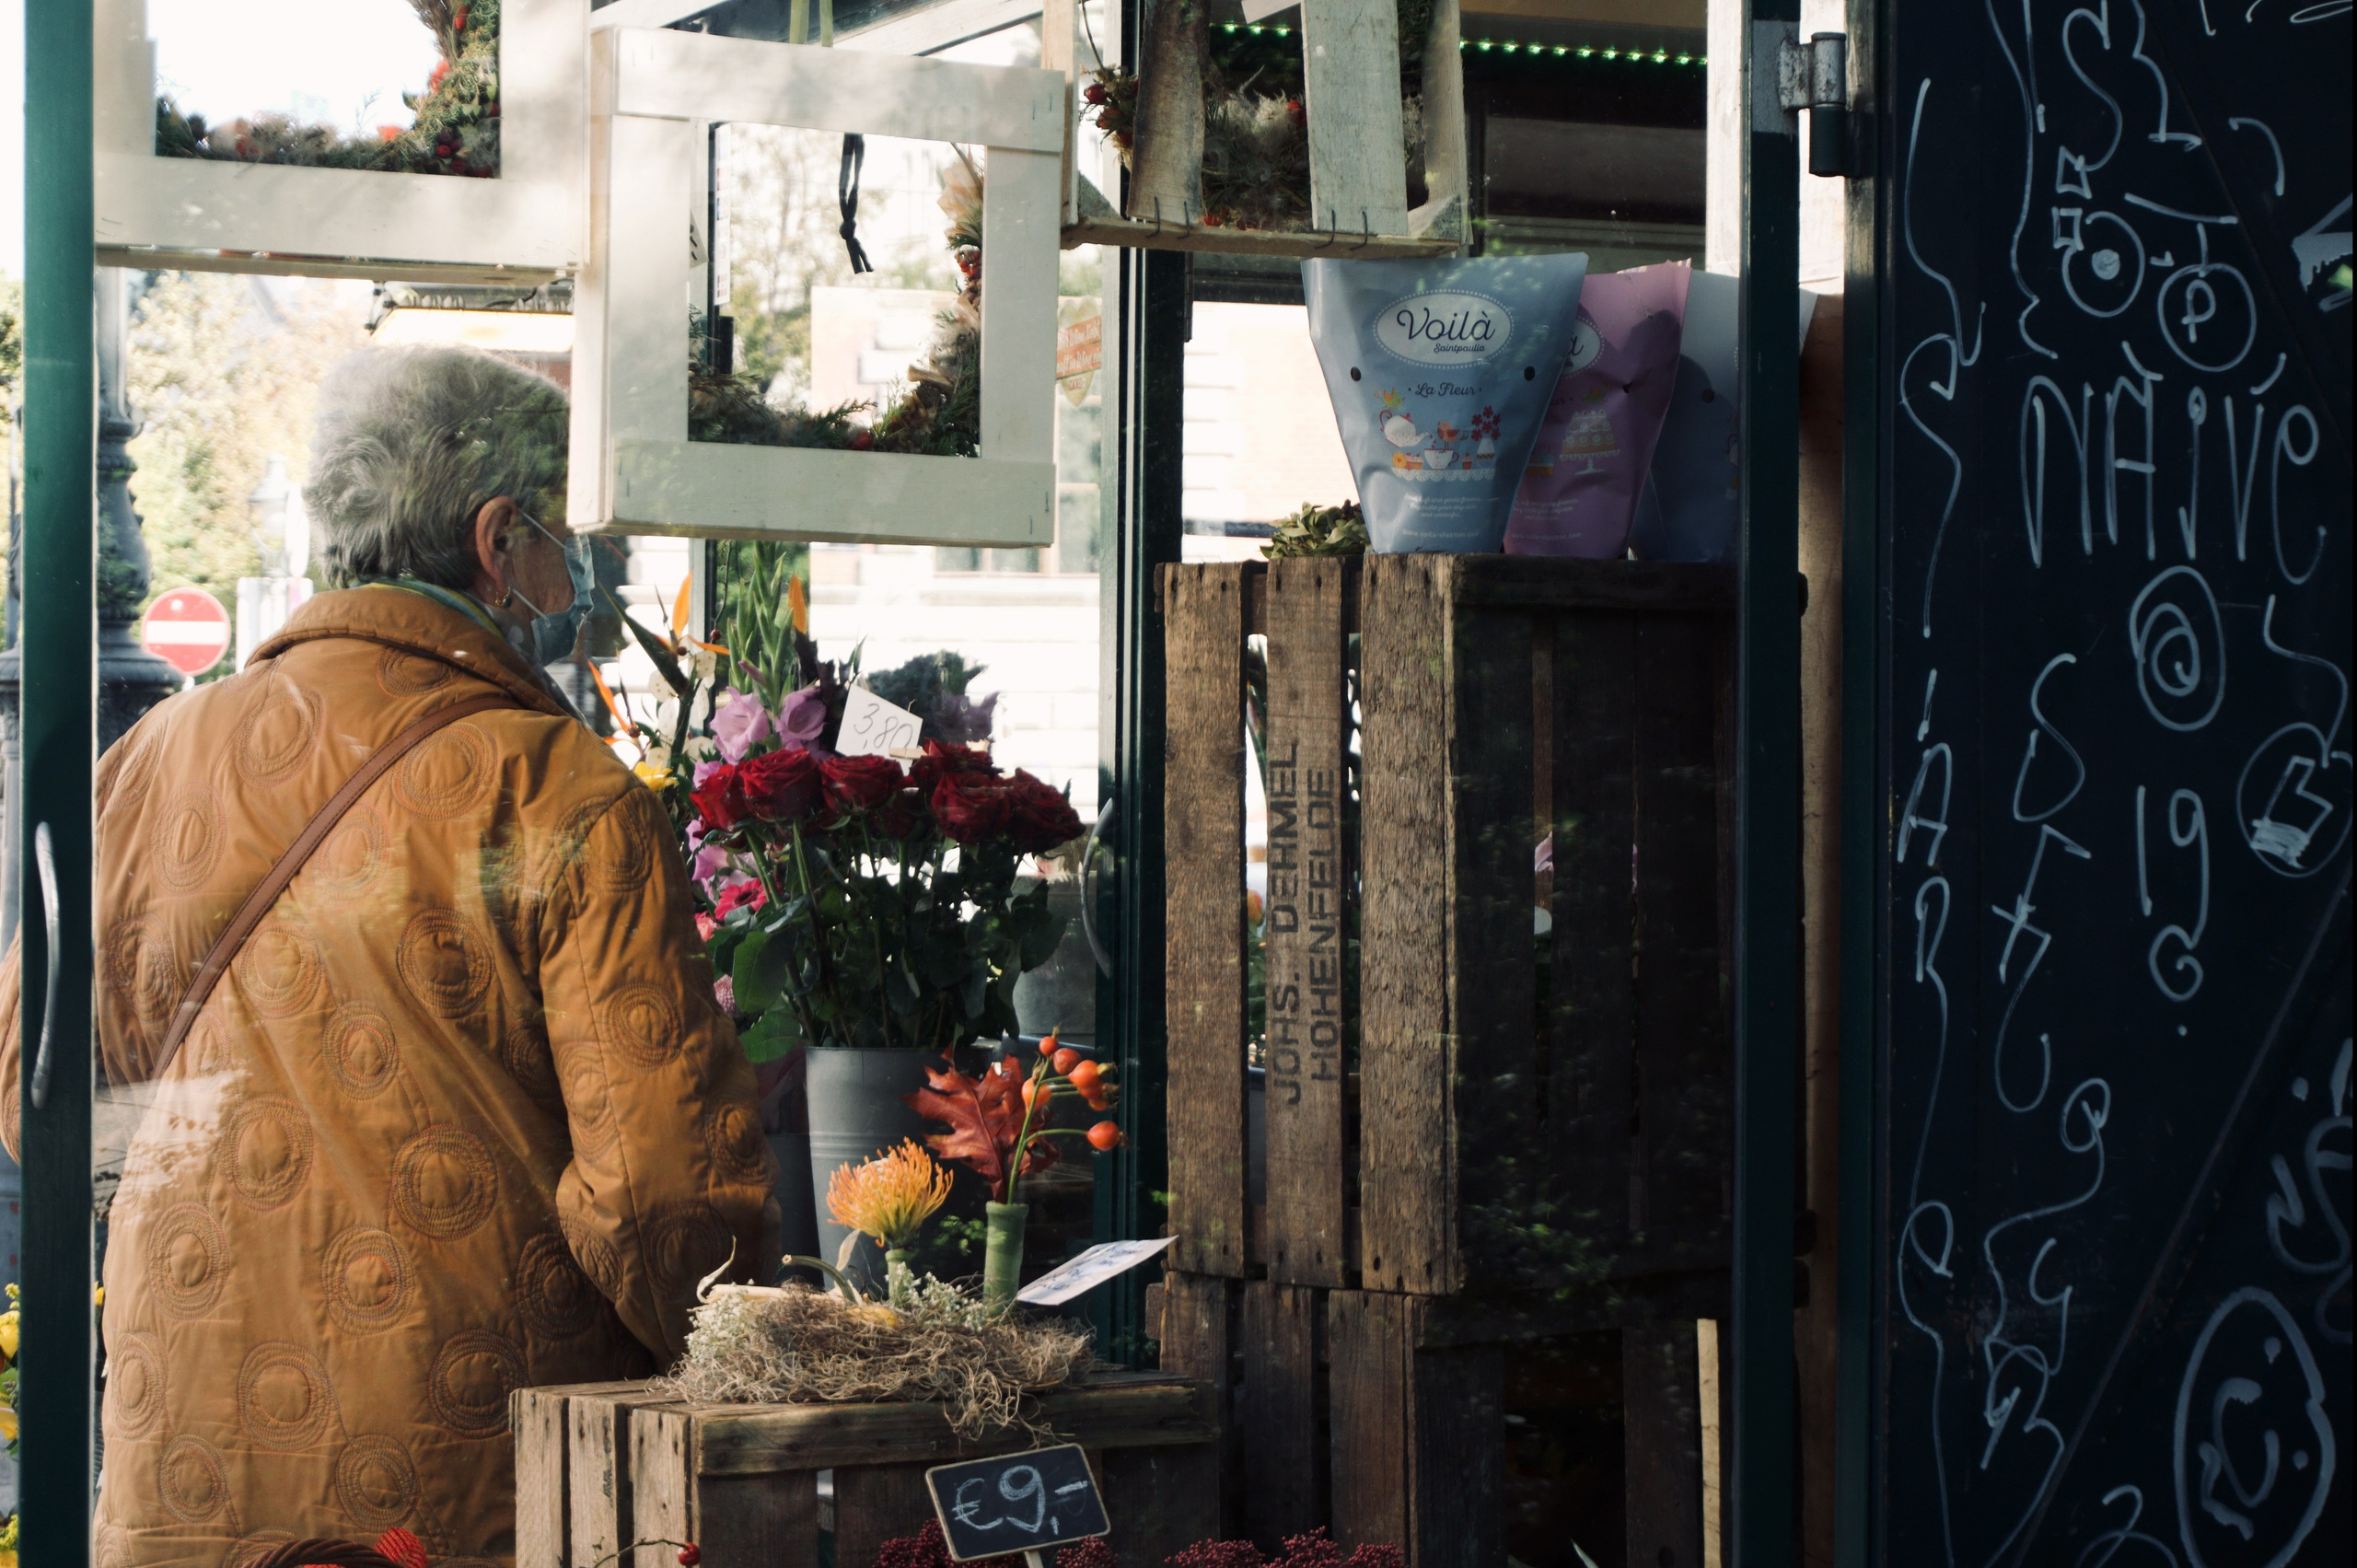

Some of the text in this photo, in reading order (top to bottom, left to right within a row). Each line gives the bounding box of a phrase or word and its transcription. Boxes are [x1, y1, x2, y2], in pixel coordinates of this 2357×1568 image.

[1396, 307, 1496, 341] Voilà
[1433, 343, 1486, 354] Saintpaulia
[1414, 381, 1477, 398] La Fleur
[853, 703, 913, 749] 3,80
[1269, 742, 1302, 1106] JOHS. DEHMEL
[1306, 767, 1339, 1081] HOHENFELDE
